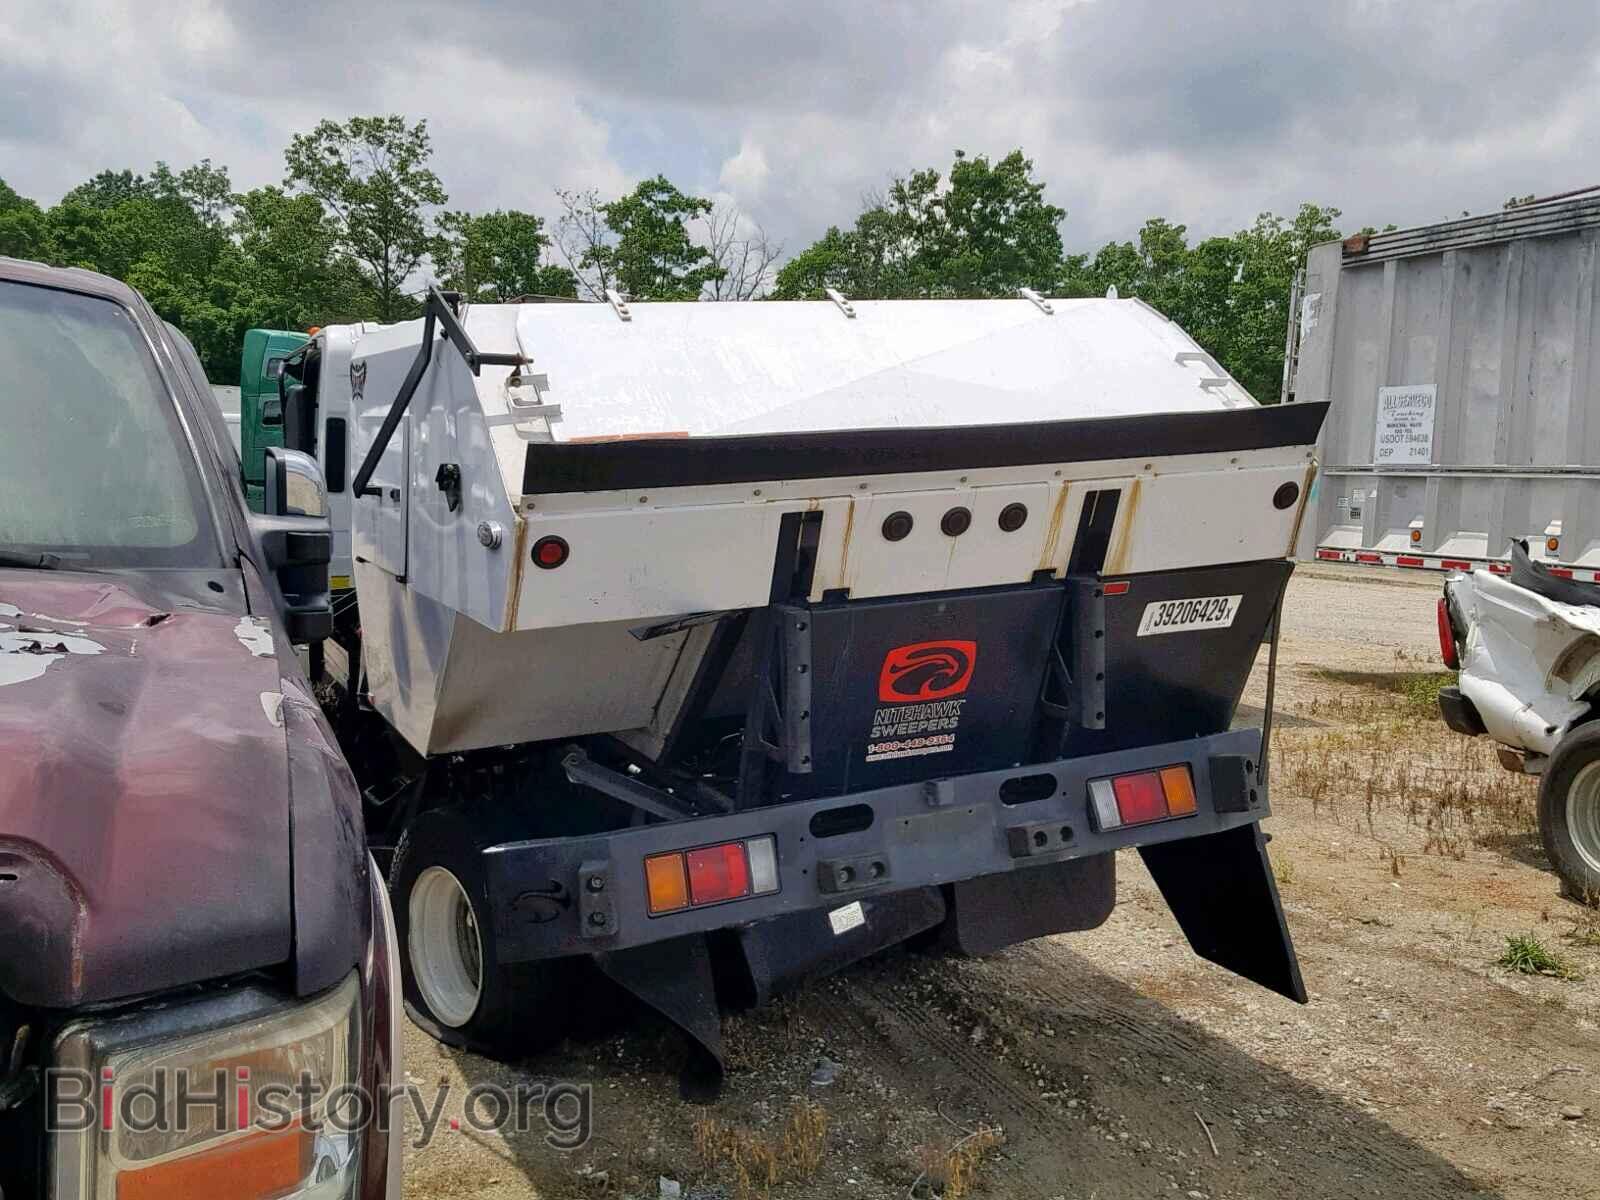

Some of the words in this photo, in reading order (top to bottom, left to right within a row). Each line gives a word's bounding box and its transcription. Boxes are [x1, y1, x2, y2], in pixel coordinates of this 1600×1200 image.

[1380, 434, 1404, 443] USDOT
[1379, 448, 1394, 457] DEP
[873, 700, 962, 726] NITEHAWK
[869, 717, 959, 739] SWEEPERS
